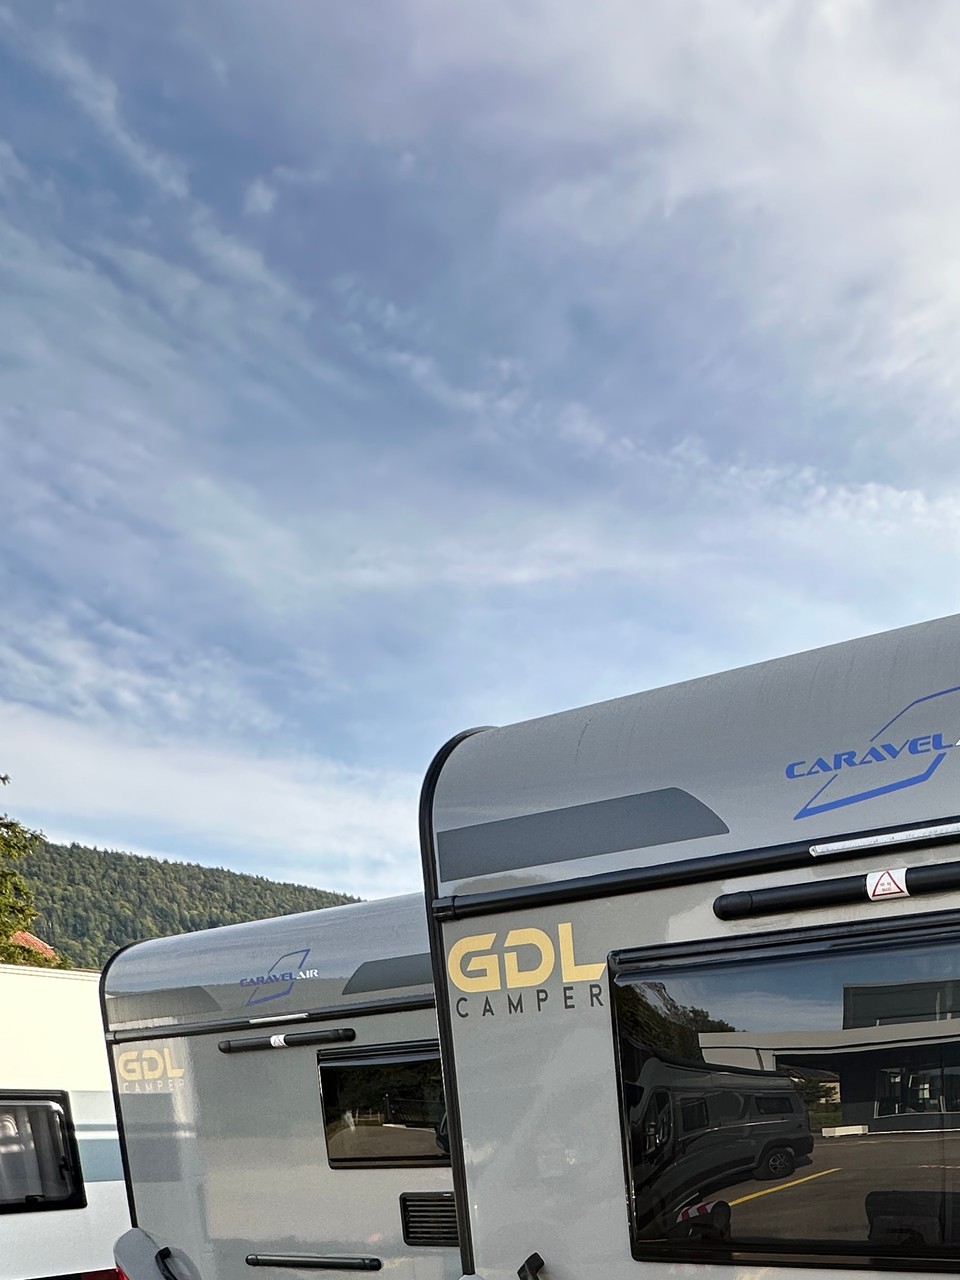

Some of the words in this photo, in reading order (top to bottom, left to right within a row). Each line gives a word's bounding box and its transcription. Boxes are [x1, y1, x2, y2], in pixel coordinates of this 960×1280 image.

[448, 922, 607, 993] GDL
[240, 969, 319, 987] CARAVELAIR
[456, 984, 604, 1018] CAMPER
[118, 1048, 185, 1081] GDL
